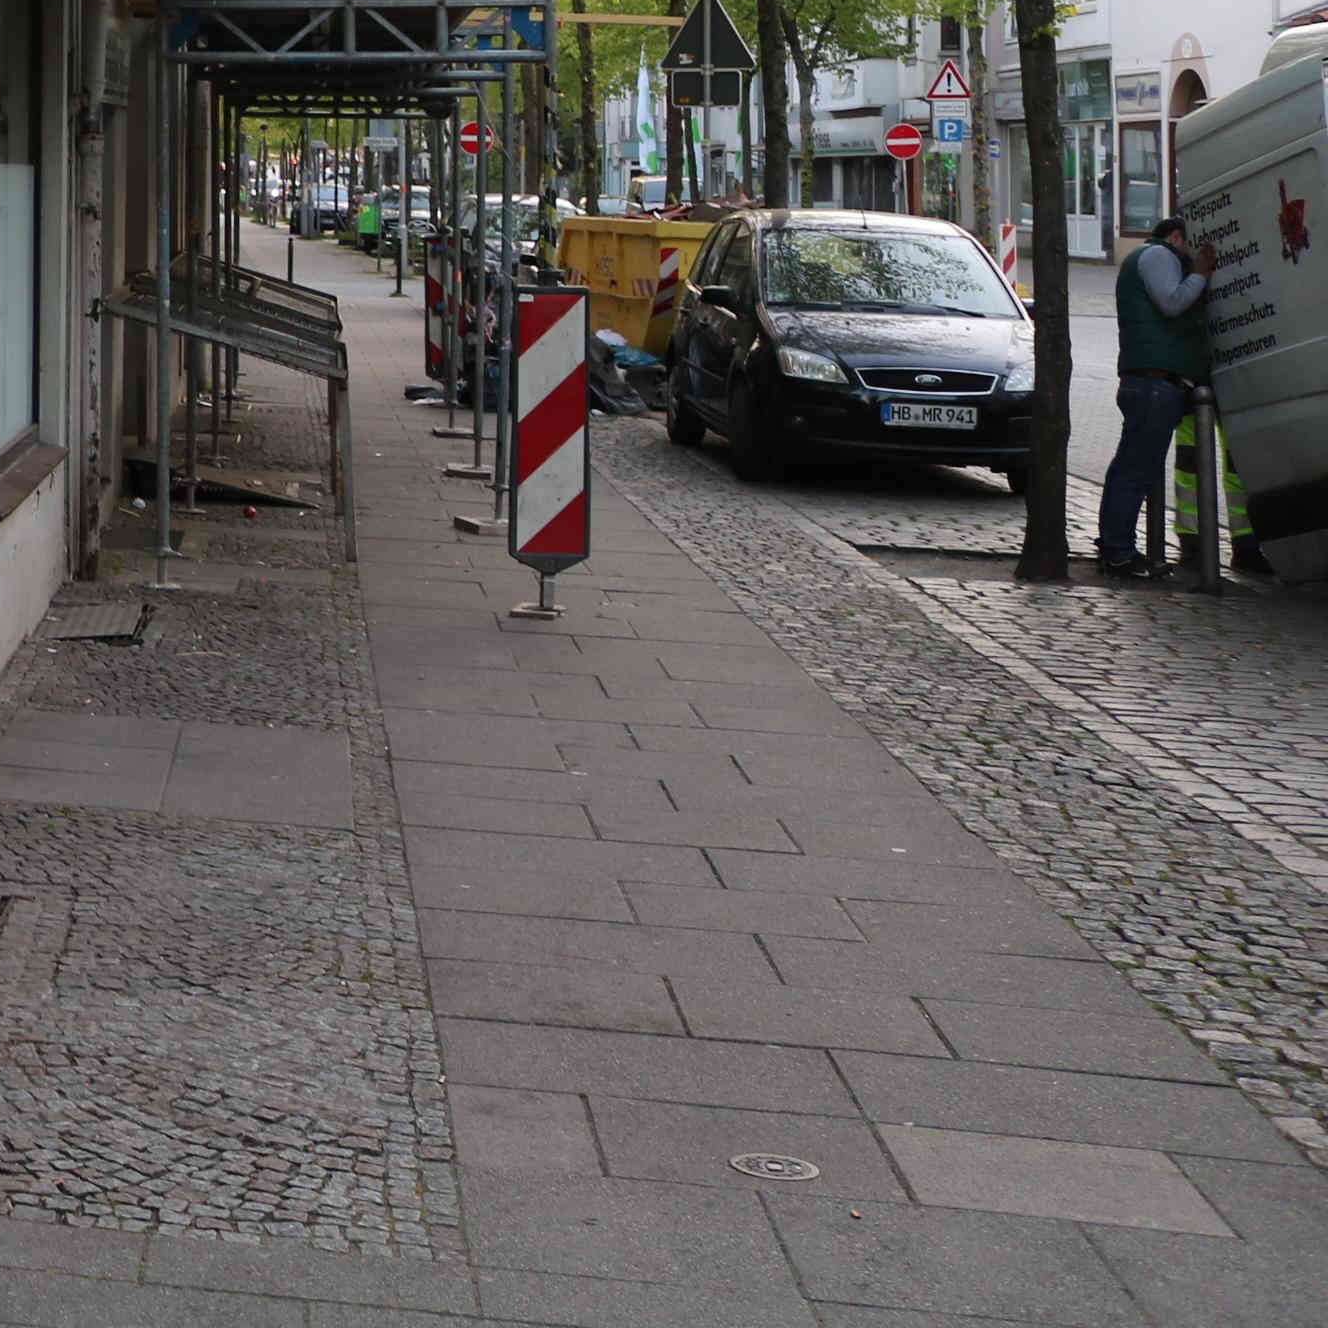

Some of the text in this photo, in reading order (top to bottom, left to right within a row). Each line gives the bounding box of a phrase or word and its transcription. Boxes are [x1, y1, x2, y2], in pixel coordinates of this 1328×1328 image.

[1190, 192, 1233, 221] Gipsputz
[891, 406, 975, 424] HB MR 941
